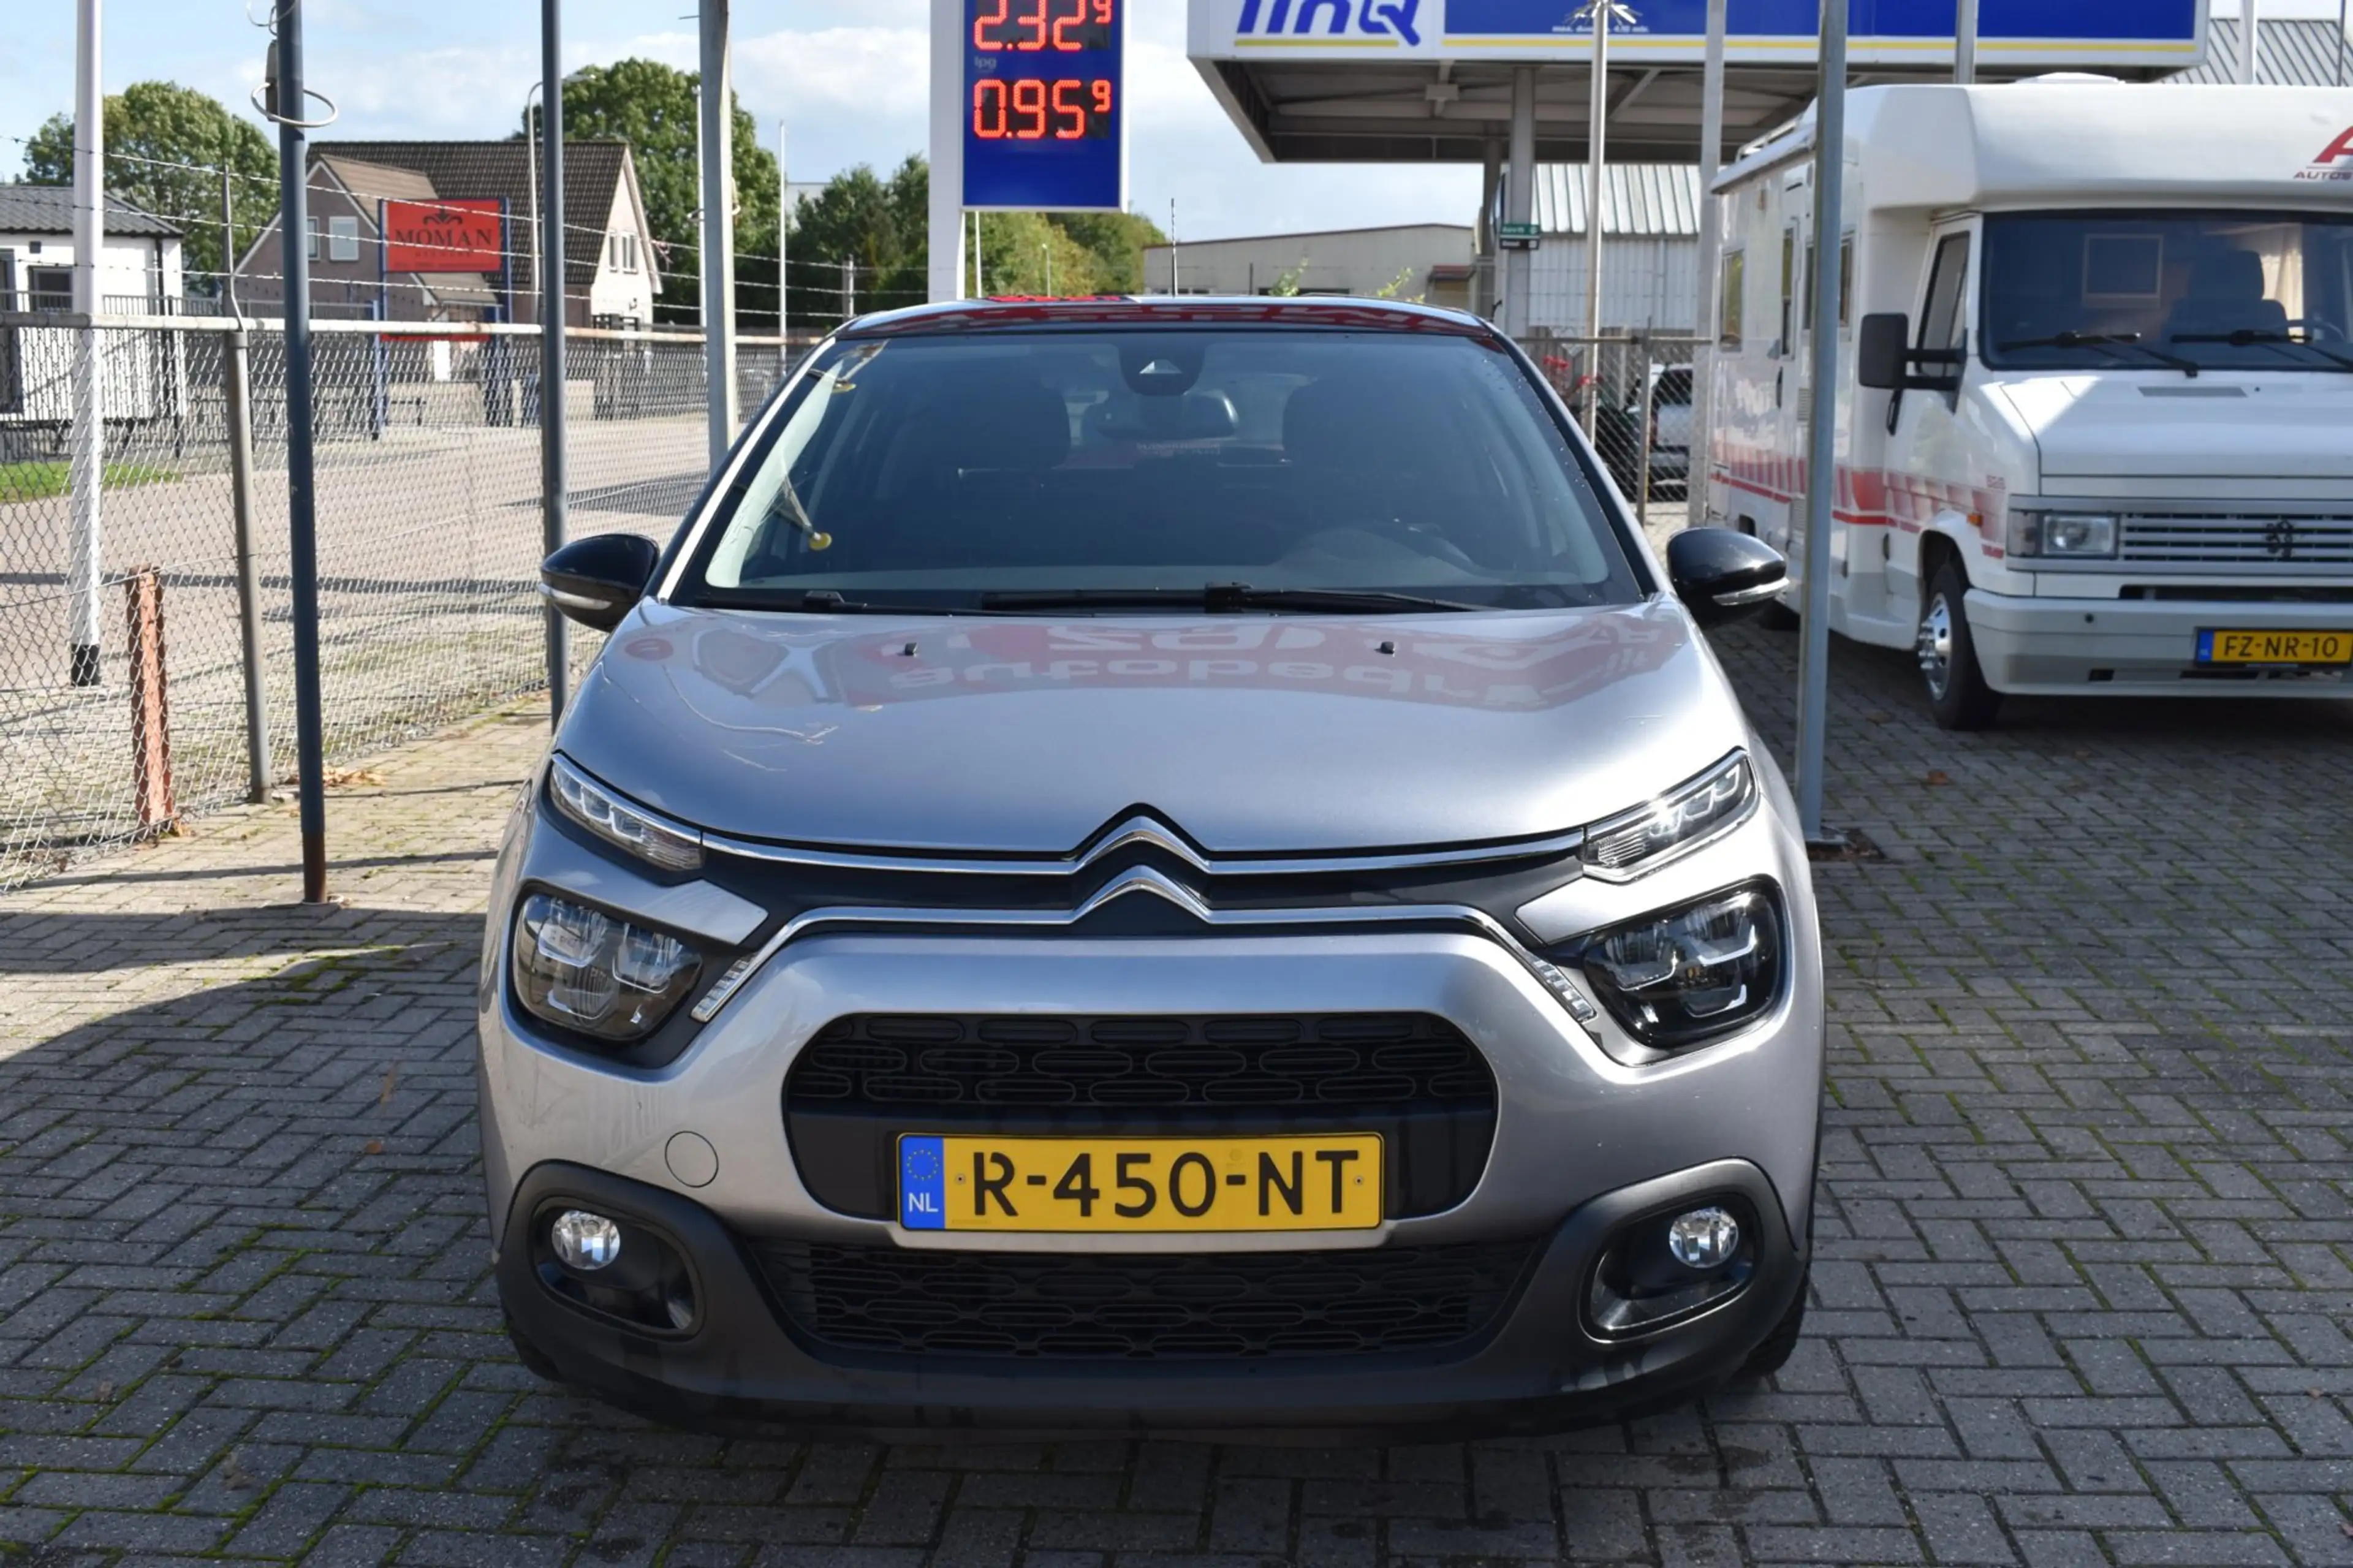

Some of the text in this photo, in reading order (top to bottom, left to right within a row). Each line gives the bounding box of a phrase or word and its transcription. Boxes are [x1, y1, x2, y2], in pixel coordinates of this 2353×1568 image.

[395, 228, 493, 246] MOMAN
[2223, 635, 2339, 659] FZ-NR-10
[972, 1150, 1358, 1218] R-450-NT
[908, 1192, 939, 1213] NL
